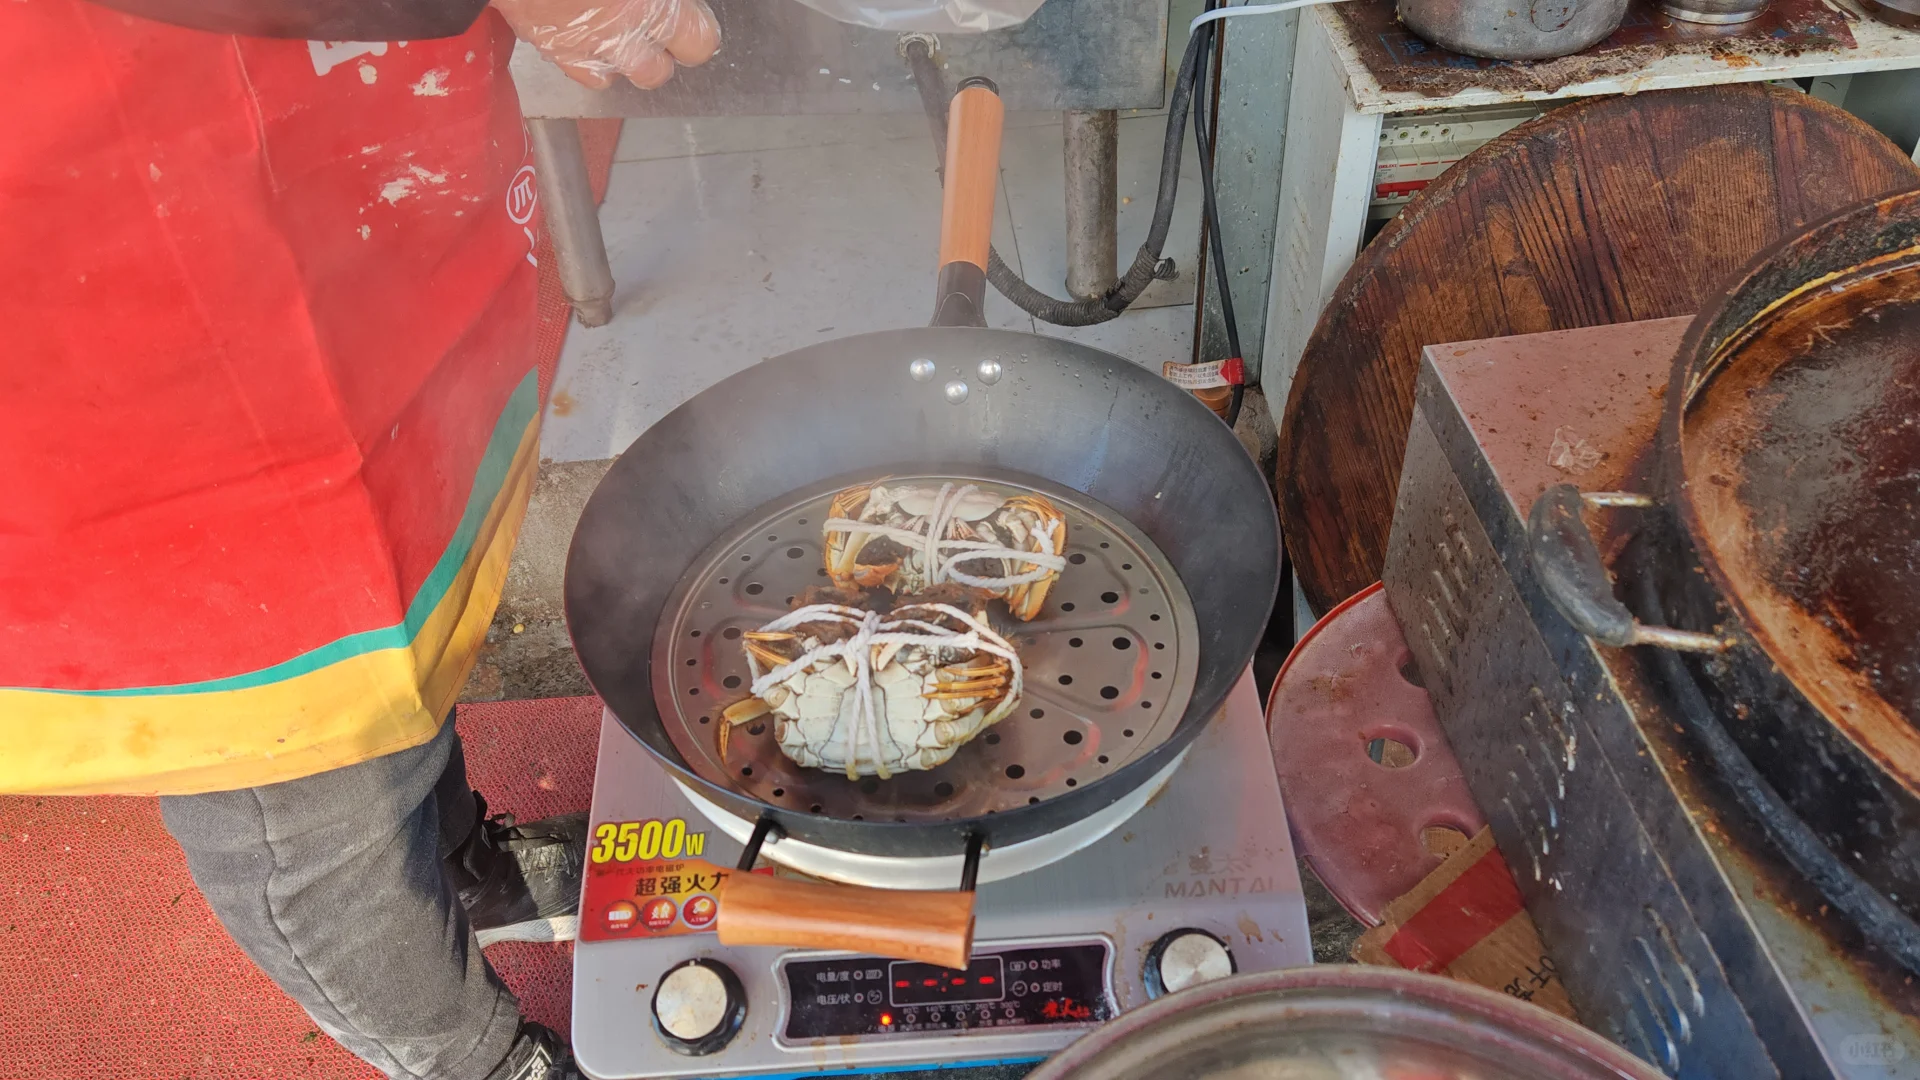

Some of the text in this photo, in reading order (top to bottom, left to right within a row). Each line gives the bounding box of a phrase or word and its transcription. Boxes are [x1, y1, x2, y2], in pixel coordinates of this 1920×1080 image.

[1164, 876, 1274, 899] MANTAI
[1041, 959, 1061, 969] 功率
[816, 970, 850, 983] 电量/度
[1042, 982, 1063, 993] 定时
[817, 993, 851, 1005] 电压/伏
